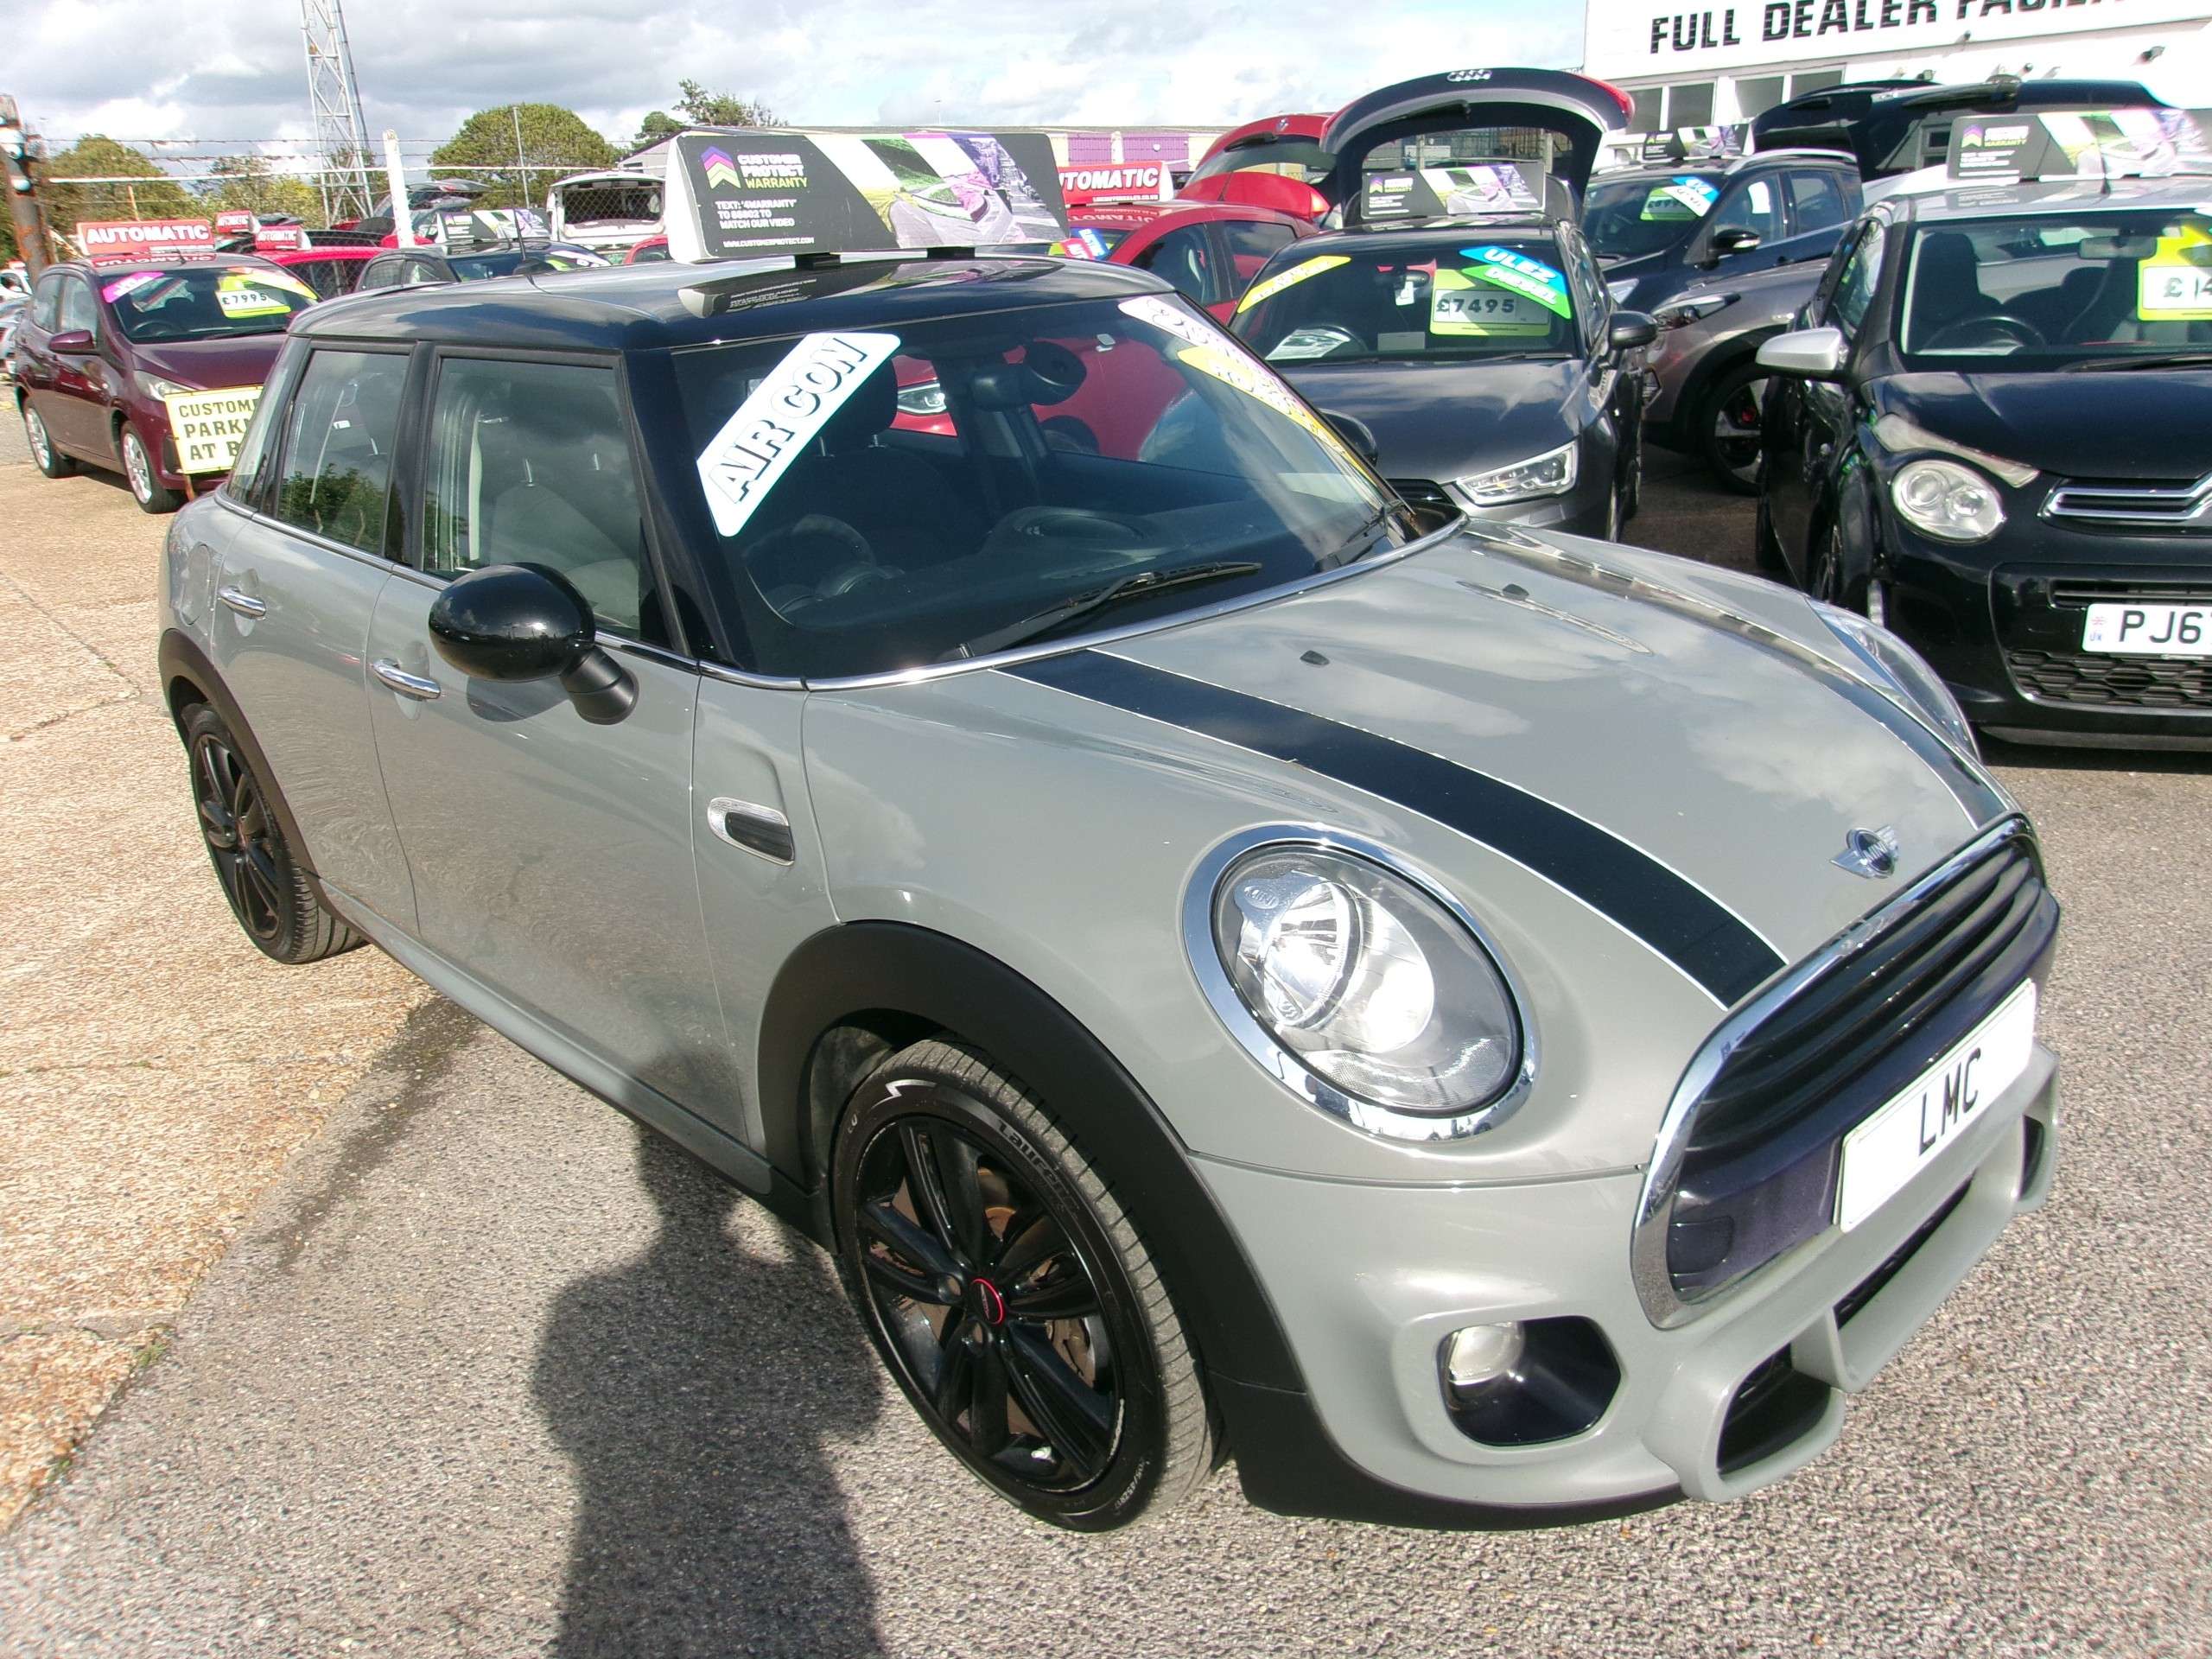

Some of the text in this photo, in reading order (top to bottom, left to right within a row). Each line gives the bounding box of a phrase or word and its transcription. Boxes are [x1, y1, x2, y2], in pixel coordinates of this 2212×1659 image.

[1649, 9, 1741, 54] FULL
[1762, 0, 1937, 42] DEALER
[737, 154, 803, 166] CUSTOMER
[740, 165, 804, 178] PROTECT
[745, 177, 809, 189] WARRANTY
[717, 210, 731, 219] TO
[760, 209, 772, 218] TO
[719, 218, 795, 230] WATCH OUR VIDEO
[86, 224, 210, 245] AUTOMATIC
[1484, 248, 1557, 284] ULEZ
[222, 292, 269, 306] £7995
[1436, 298, 1515, 314] £7495
[708, 419, 796, 505] AIR
[770, 336, 868, 419] CON
[190, 442, 216, 461] AT
[2119, 609, 2212, 645] PJ6
[1918, 1046, 1982, 1157] LMC
